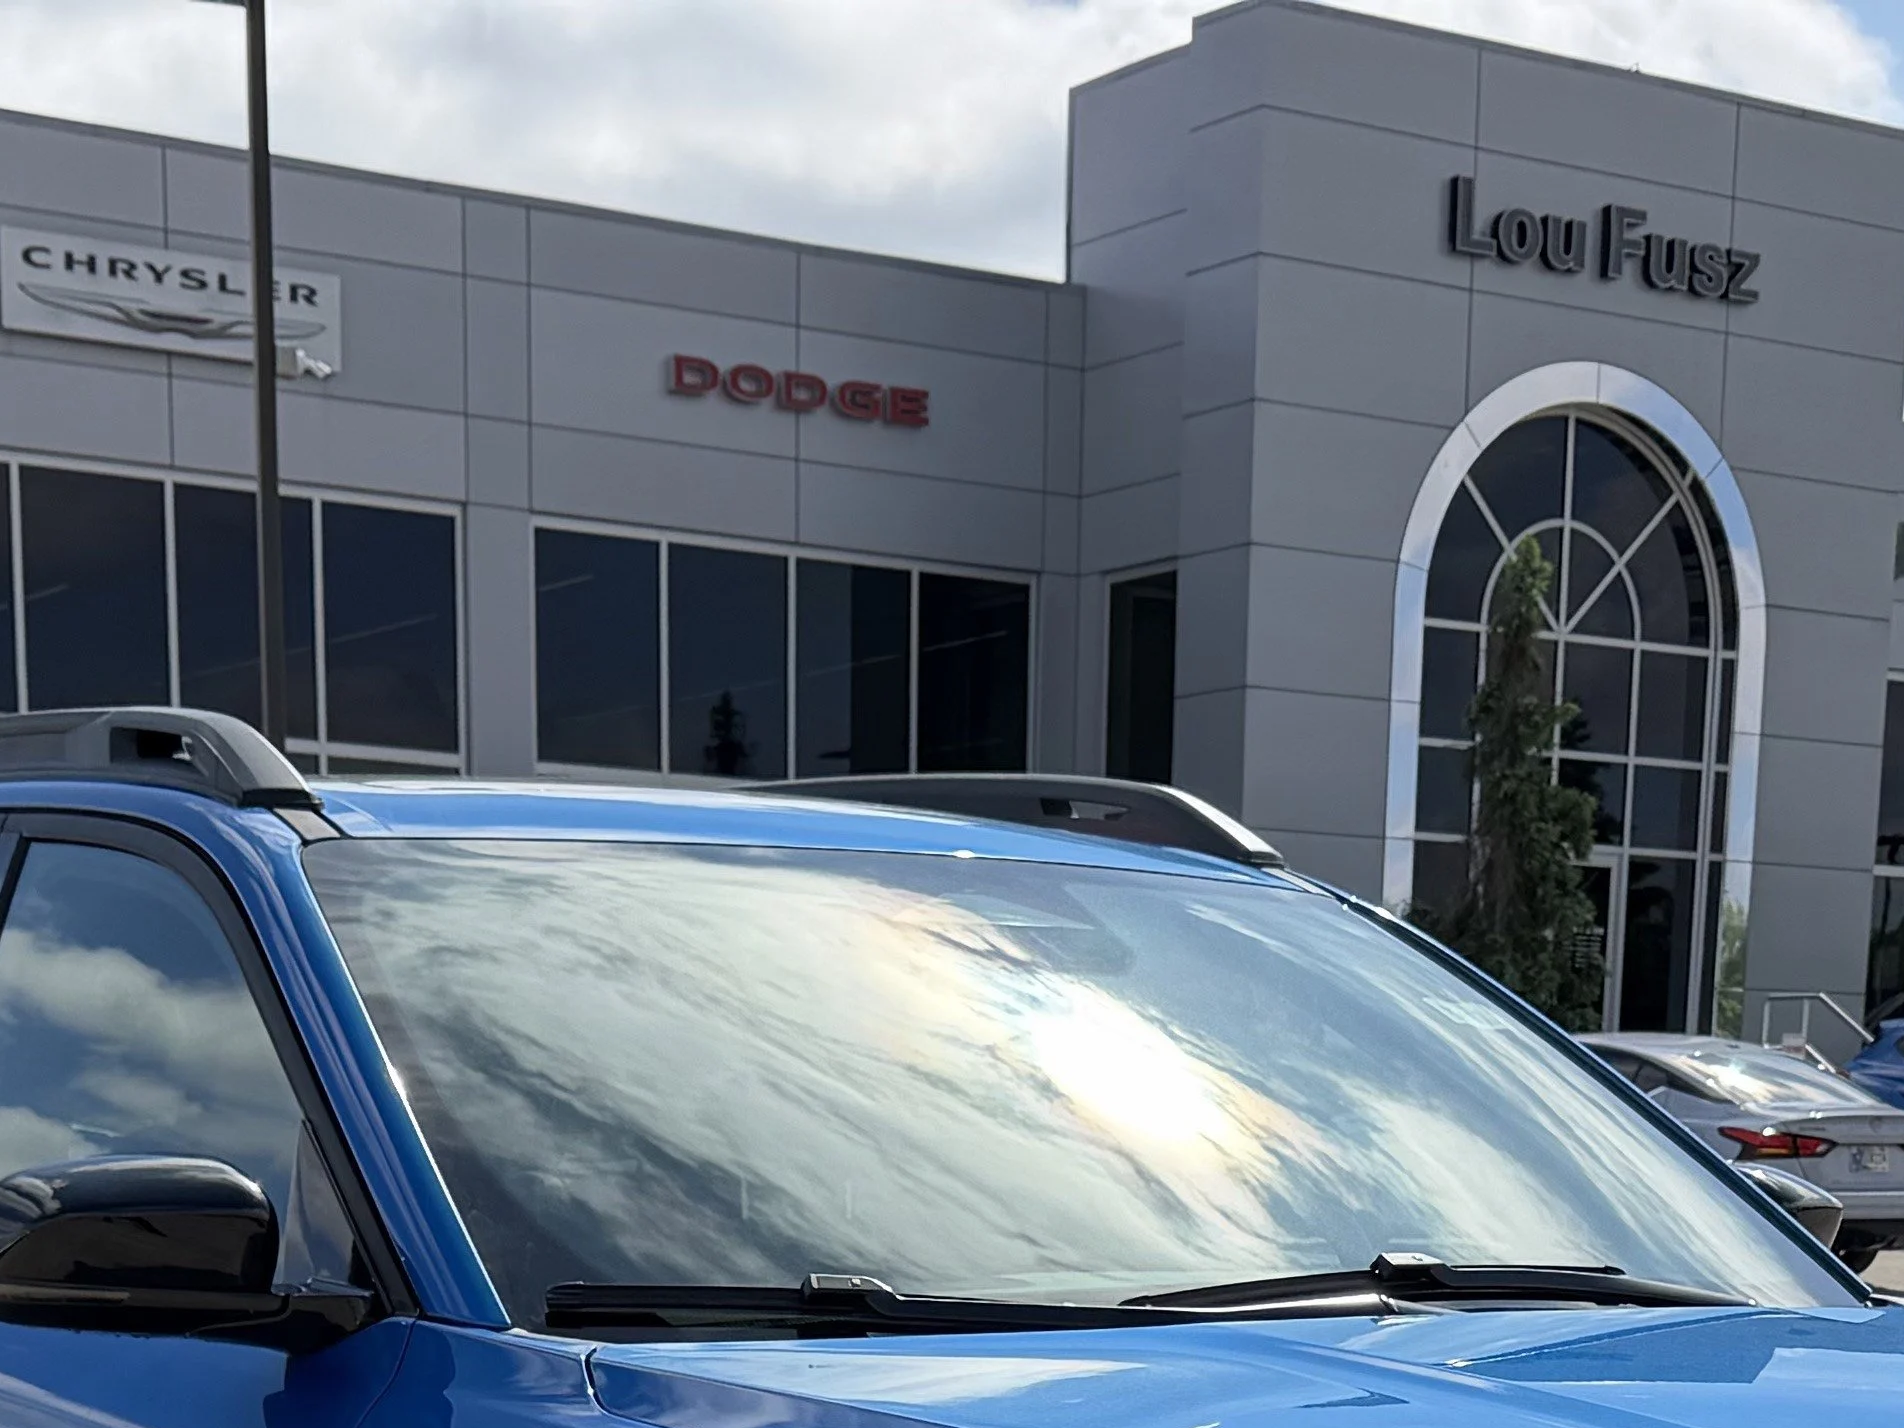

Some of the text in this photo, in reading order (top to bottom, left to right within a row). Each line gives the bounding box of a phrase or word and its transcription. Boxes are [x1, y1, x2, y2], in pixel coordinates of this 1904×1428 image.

[1448, 174, 1761, 304] Lou Fusz
[668, 353, 931, 427] DODGE
